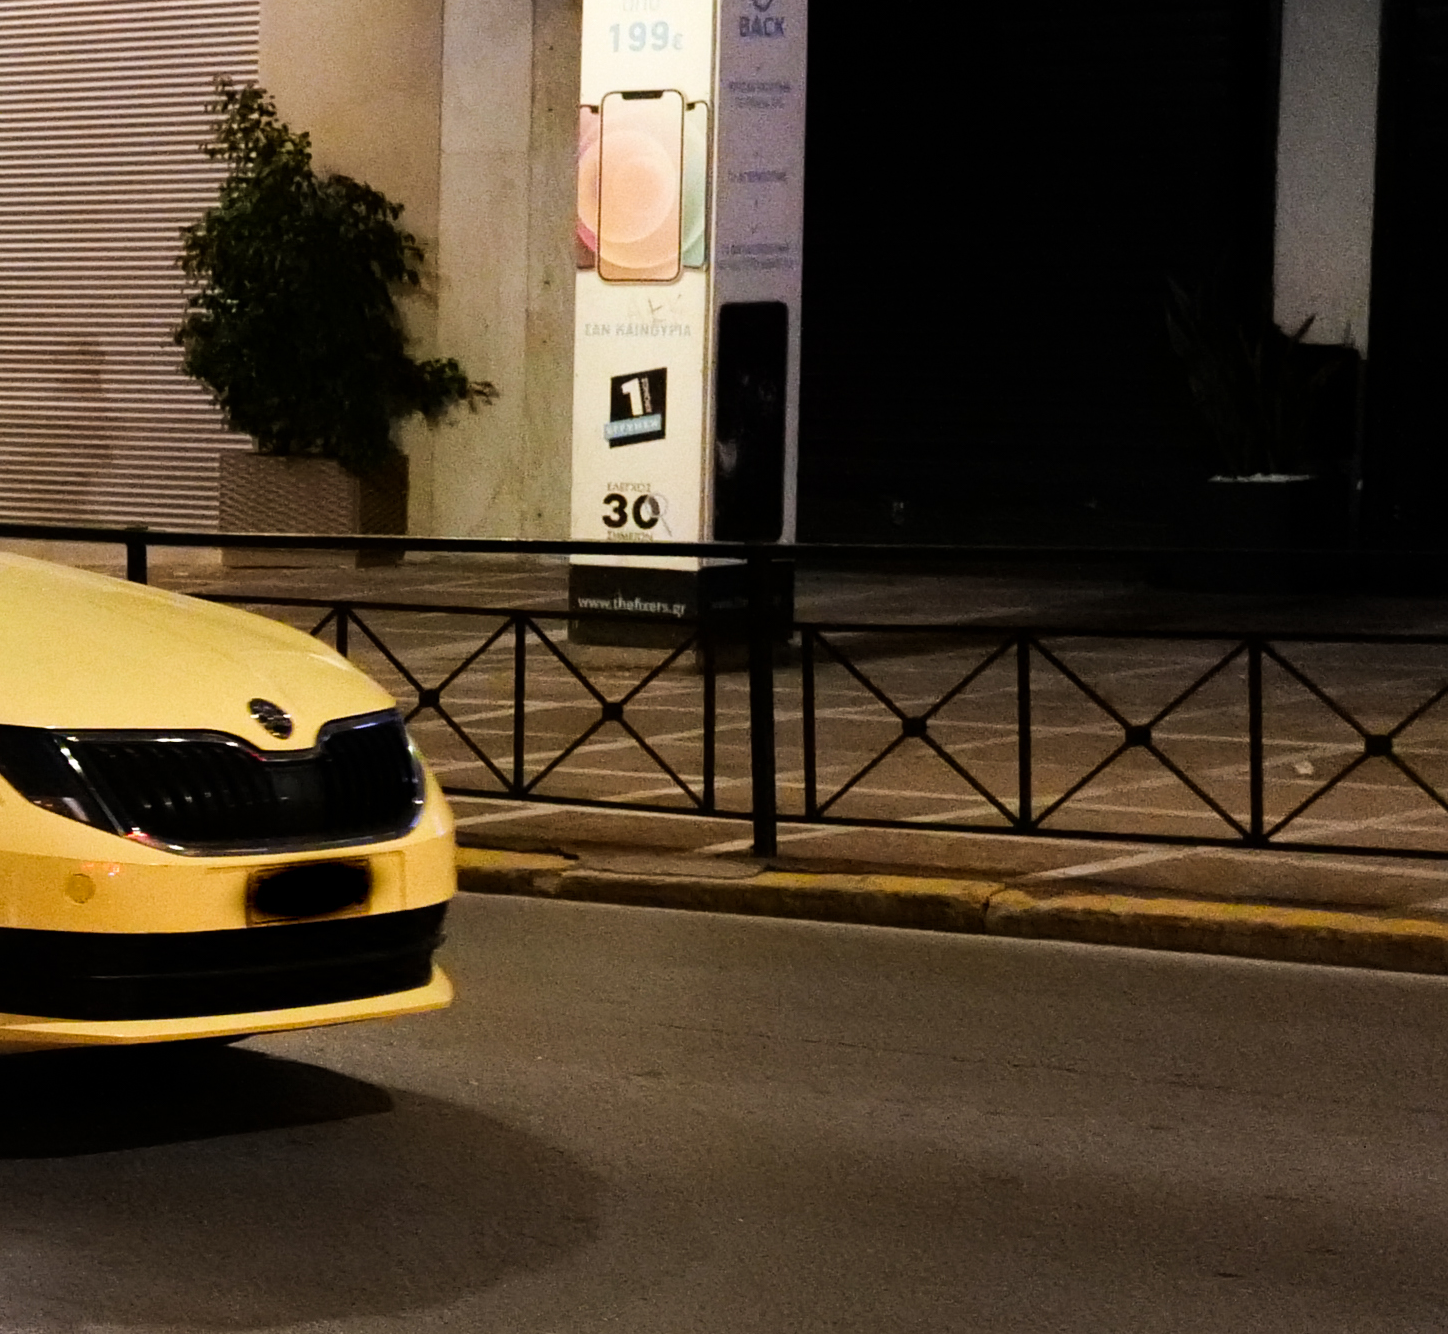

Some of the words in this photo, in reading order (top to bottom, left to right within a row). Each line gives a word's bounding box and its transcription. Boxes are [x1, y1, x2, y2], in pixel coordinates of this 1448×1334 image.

[739, 15, 785, 37] BACK
[602, 493, 661, 529] 30
[577, 595, 686, 618] www.thefixers.gr
